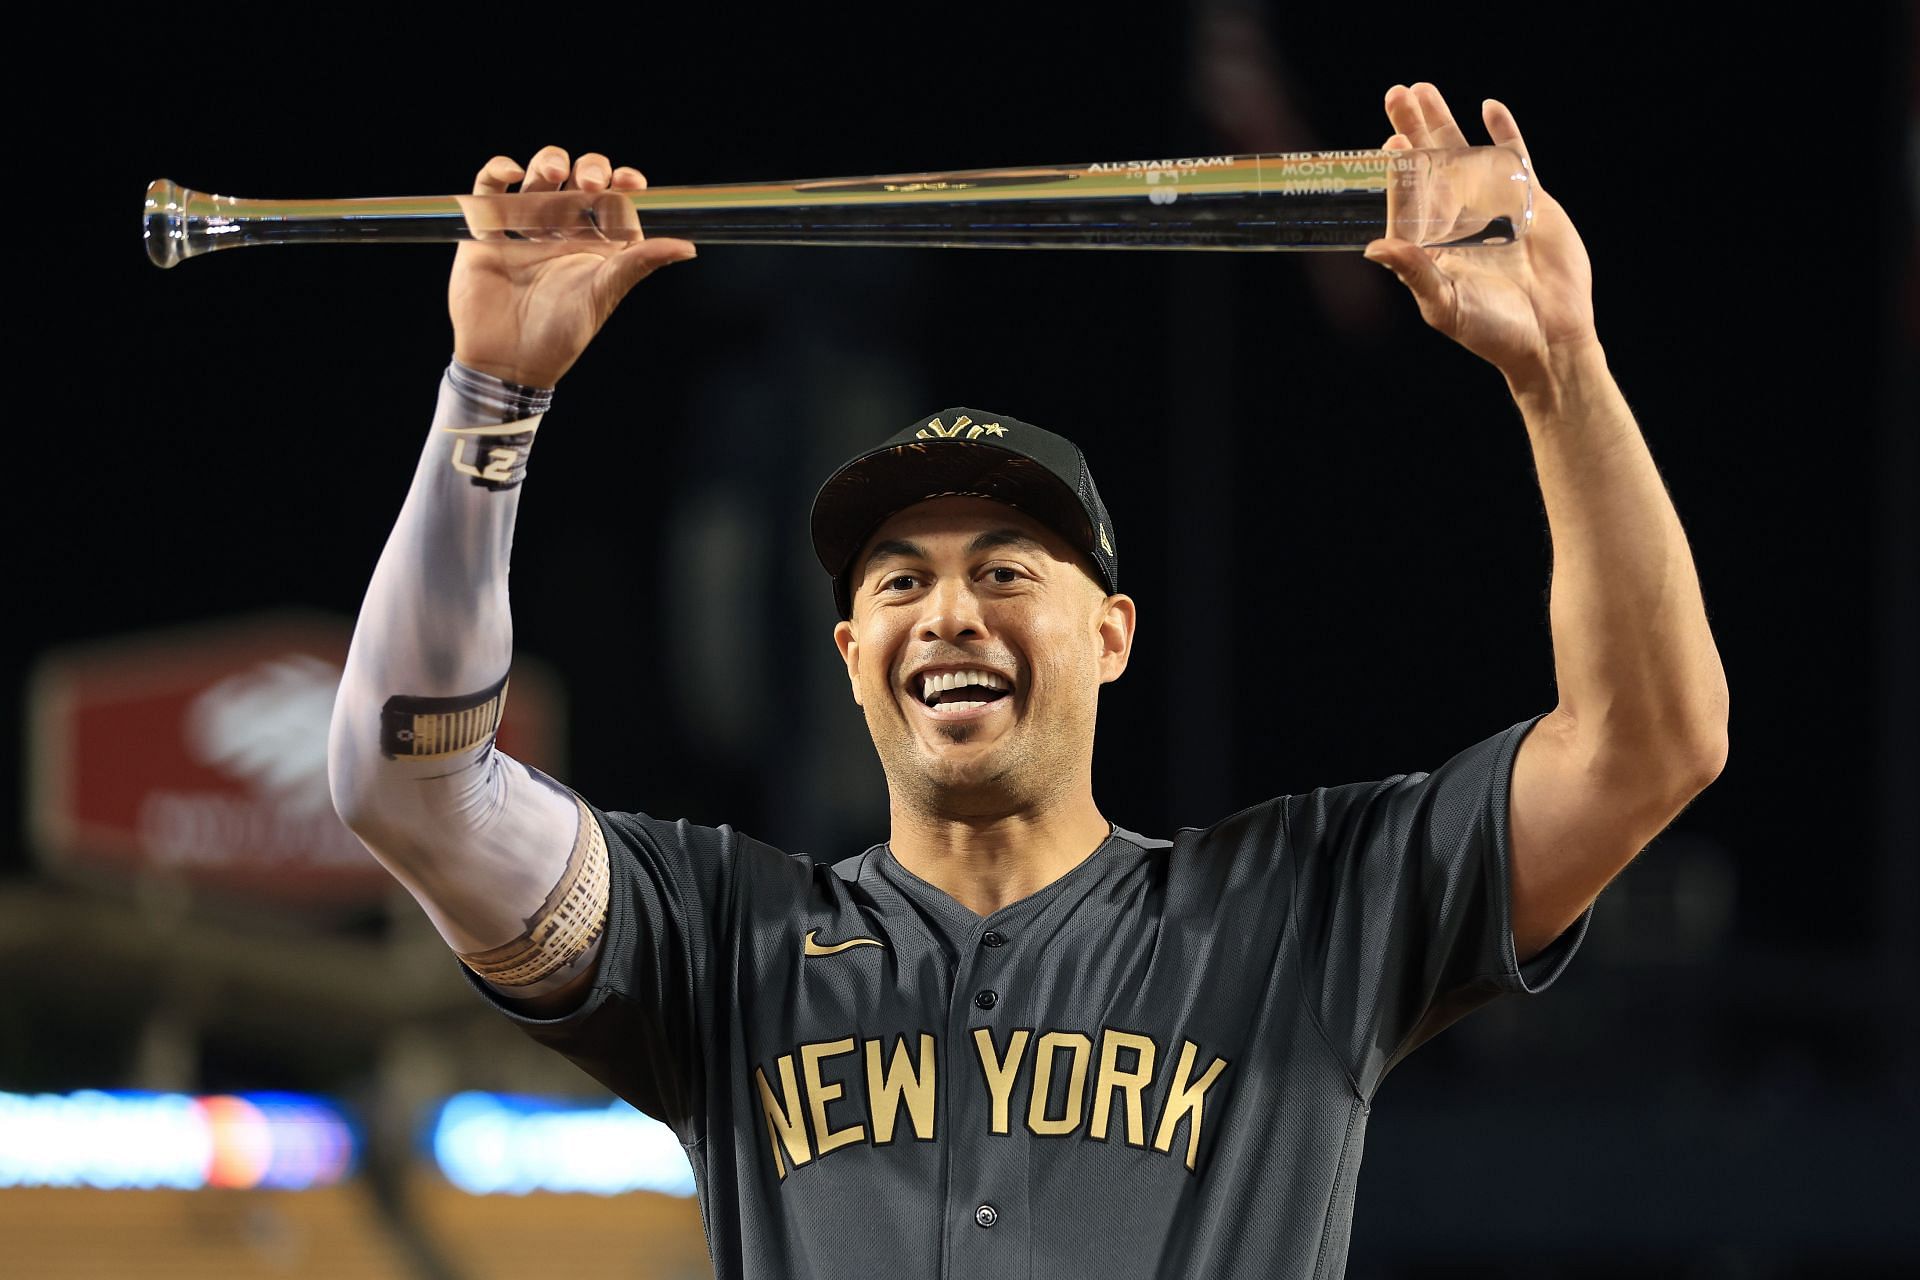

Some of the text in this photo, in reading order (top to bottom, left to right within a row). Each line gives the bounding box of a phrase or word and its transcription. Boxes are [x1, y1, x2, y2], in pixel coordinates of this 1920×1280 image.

[1176, 156, 1234, 168] GAME
[1281, 152, 1312, 161] TED
[1281, 161, 1335, 176] MOST
[1283, 177, 1346, 196] AWARD
[755, 1026, 1228, 1180] NEW YORK
